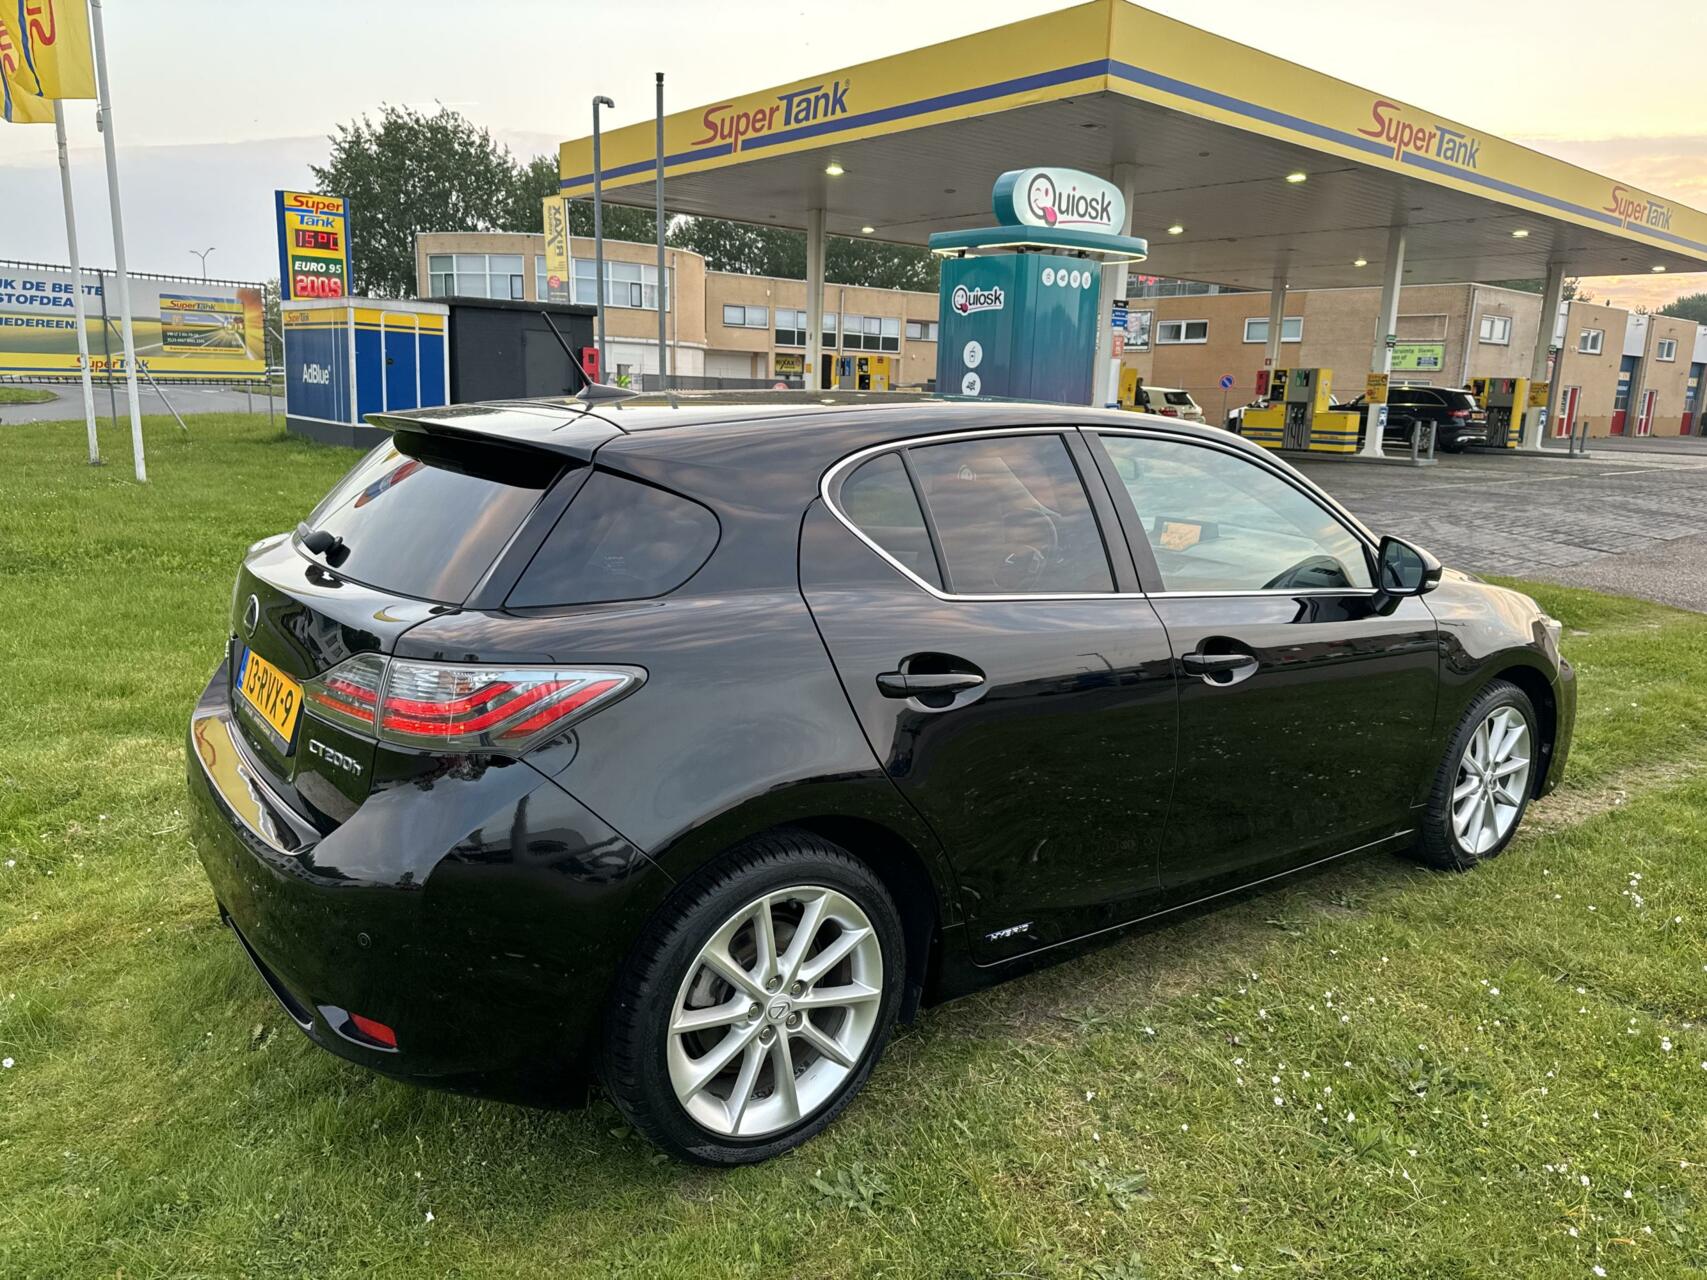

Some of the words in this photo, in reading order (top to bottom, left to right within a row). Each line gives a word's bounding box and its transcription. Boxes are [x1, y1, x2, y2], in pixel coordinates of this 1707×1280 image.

[286, 195, 343, 215] Super
[1027, 173, 1112, 227] Quiosk
[295, 213, 336, 228] Tank
[294, 260, 327, 273] EURO
[328, 263, 343, 274] 95
[21, 280, 47, 292] DE
[51, 282, 103, 297] BETE
[953, 287, 1002, 313] Quiosk
[70, 356, 149, 373] SperTk
[302, 363, 330, 385] AdBlue
[245, 655, 294, 728] 13-RVX-9
